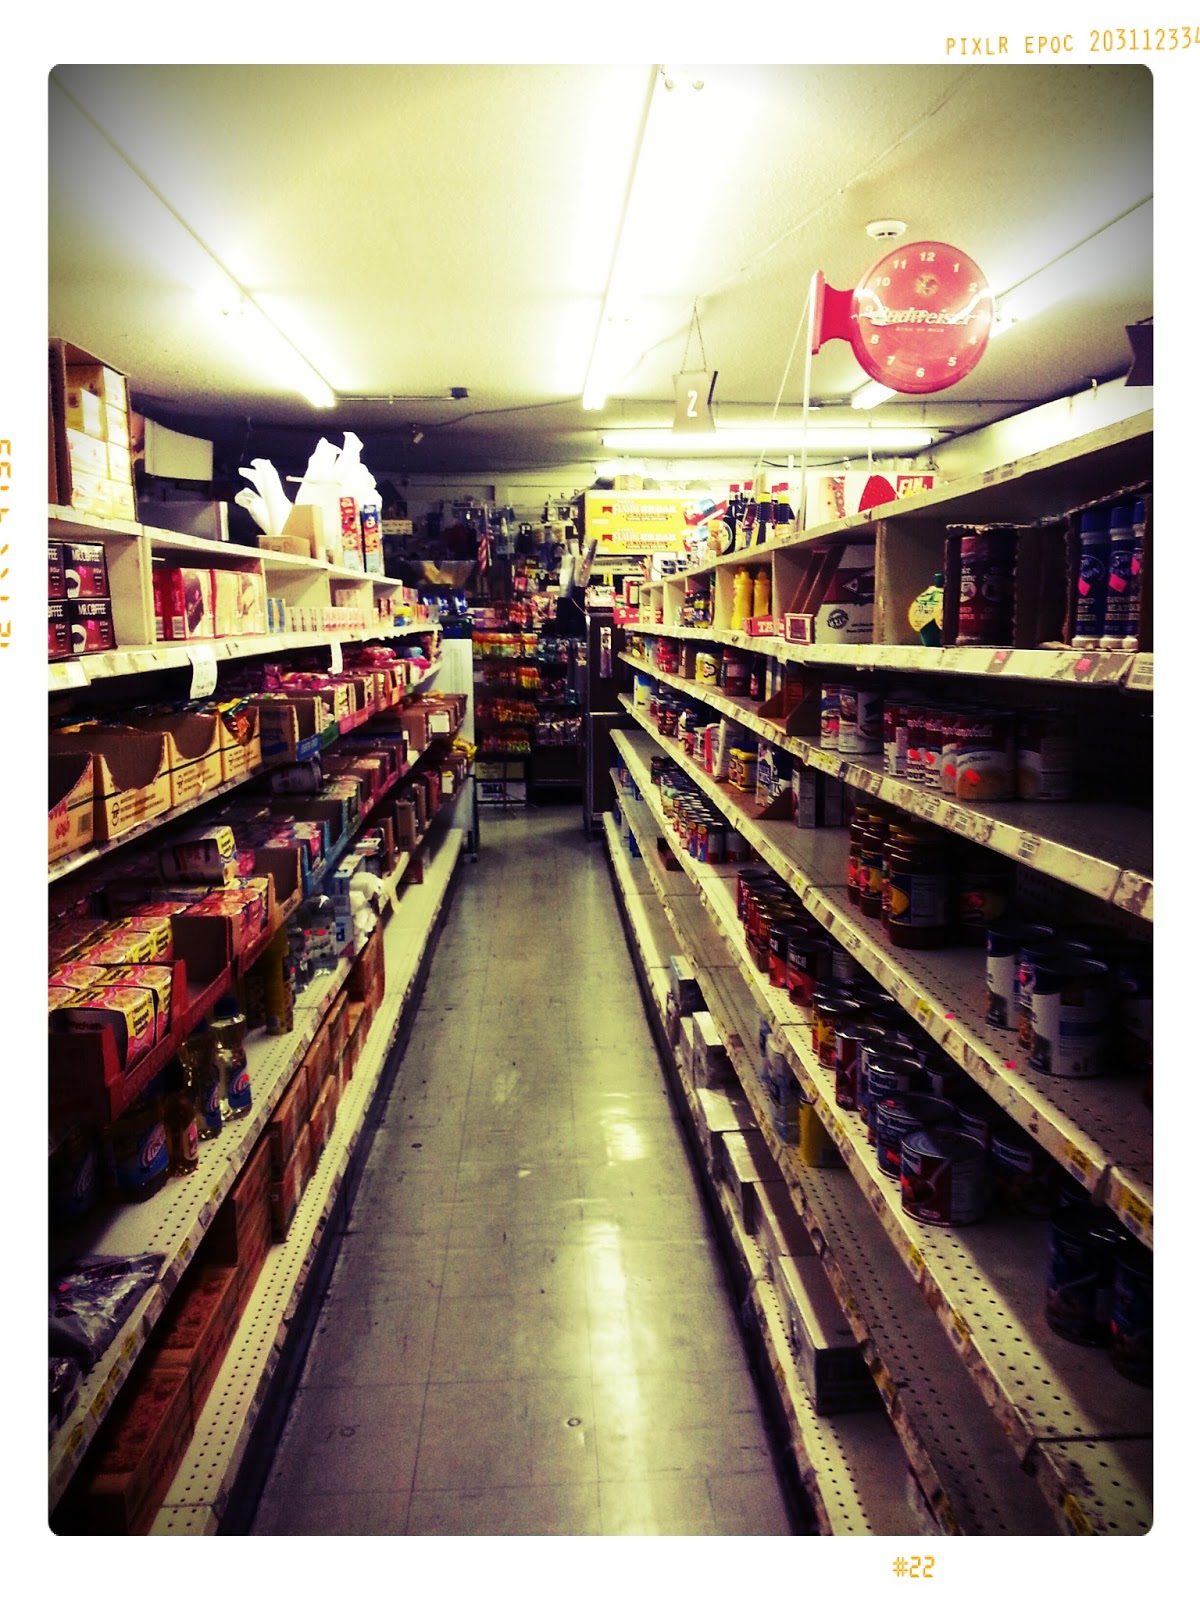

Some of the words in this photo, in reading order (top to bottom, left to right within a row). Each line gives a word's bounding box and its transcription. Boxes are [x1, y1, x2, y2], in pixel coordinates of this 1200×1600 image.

[920, 251, 936, 262] 12
[893, 259, 907, 270] 11
[952, 262, 960, 273] 1
[968, 282, 978, 292] 2
[870, 334, 880, 345] 8
[968, 335, 977, 345] 4
[887, 355, 896, 366] 7
[947, 356, 957, 367] 5
[916, 367, 926, 378] 6
[686, 389, 698, 418] 2
